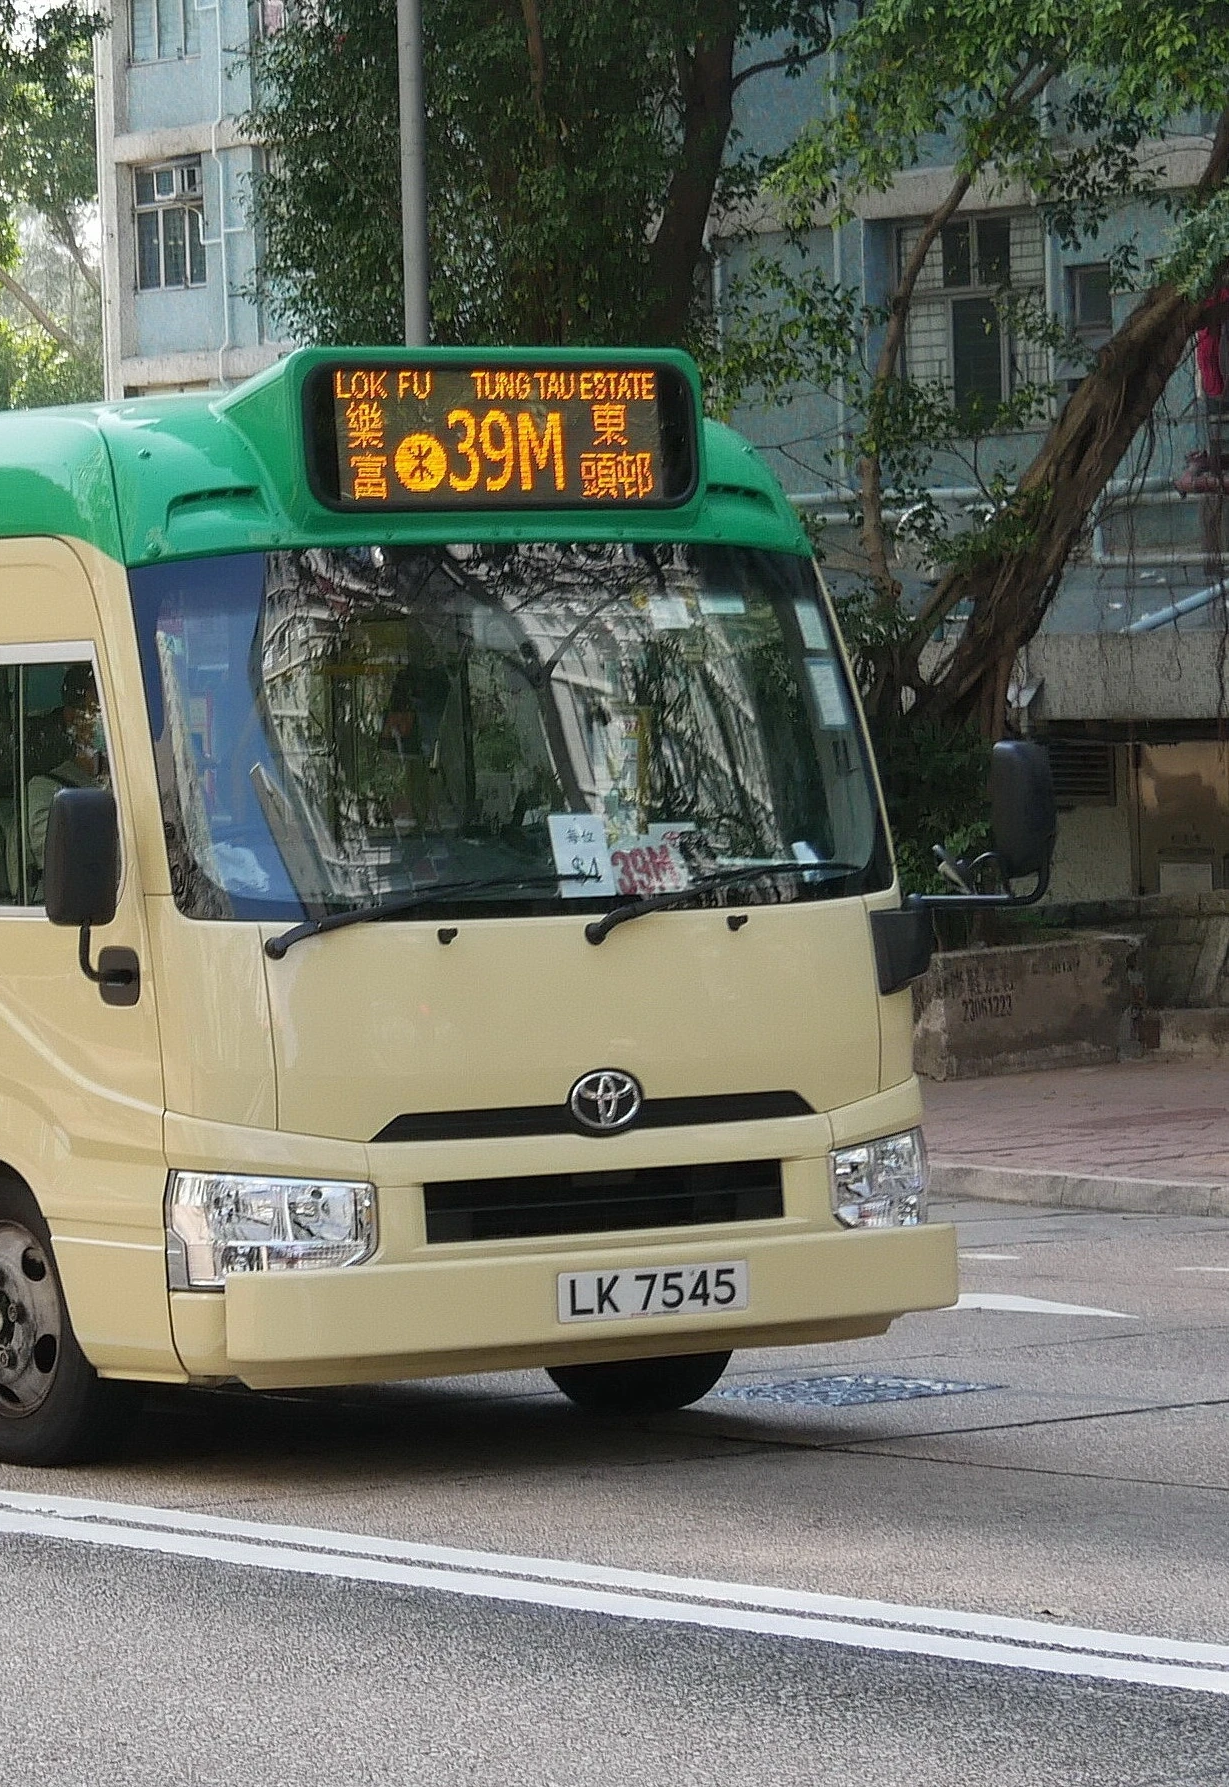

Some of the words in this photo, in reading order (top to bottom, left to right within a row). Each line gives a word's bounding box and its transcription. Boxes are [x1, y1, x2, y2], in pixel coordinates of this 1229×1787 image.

[335, 371, 388, 400] LOK
[397, 371, 432, 400] FU
[471, 371, 532, 401] TUNG
[534, 372, 575, 401] TAU
[579, 372, 656, 401] ESTATE
[345, 401, 388, 500] 樂富
[446, 409, 565, 493] 39M
[569, 1275, 620, 1316] LK
[634, 1267, 737, 1312] 7545
